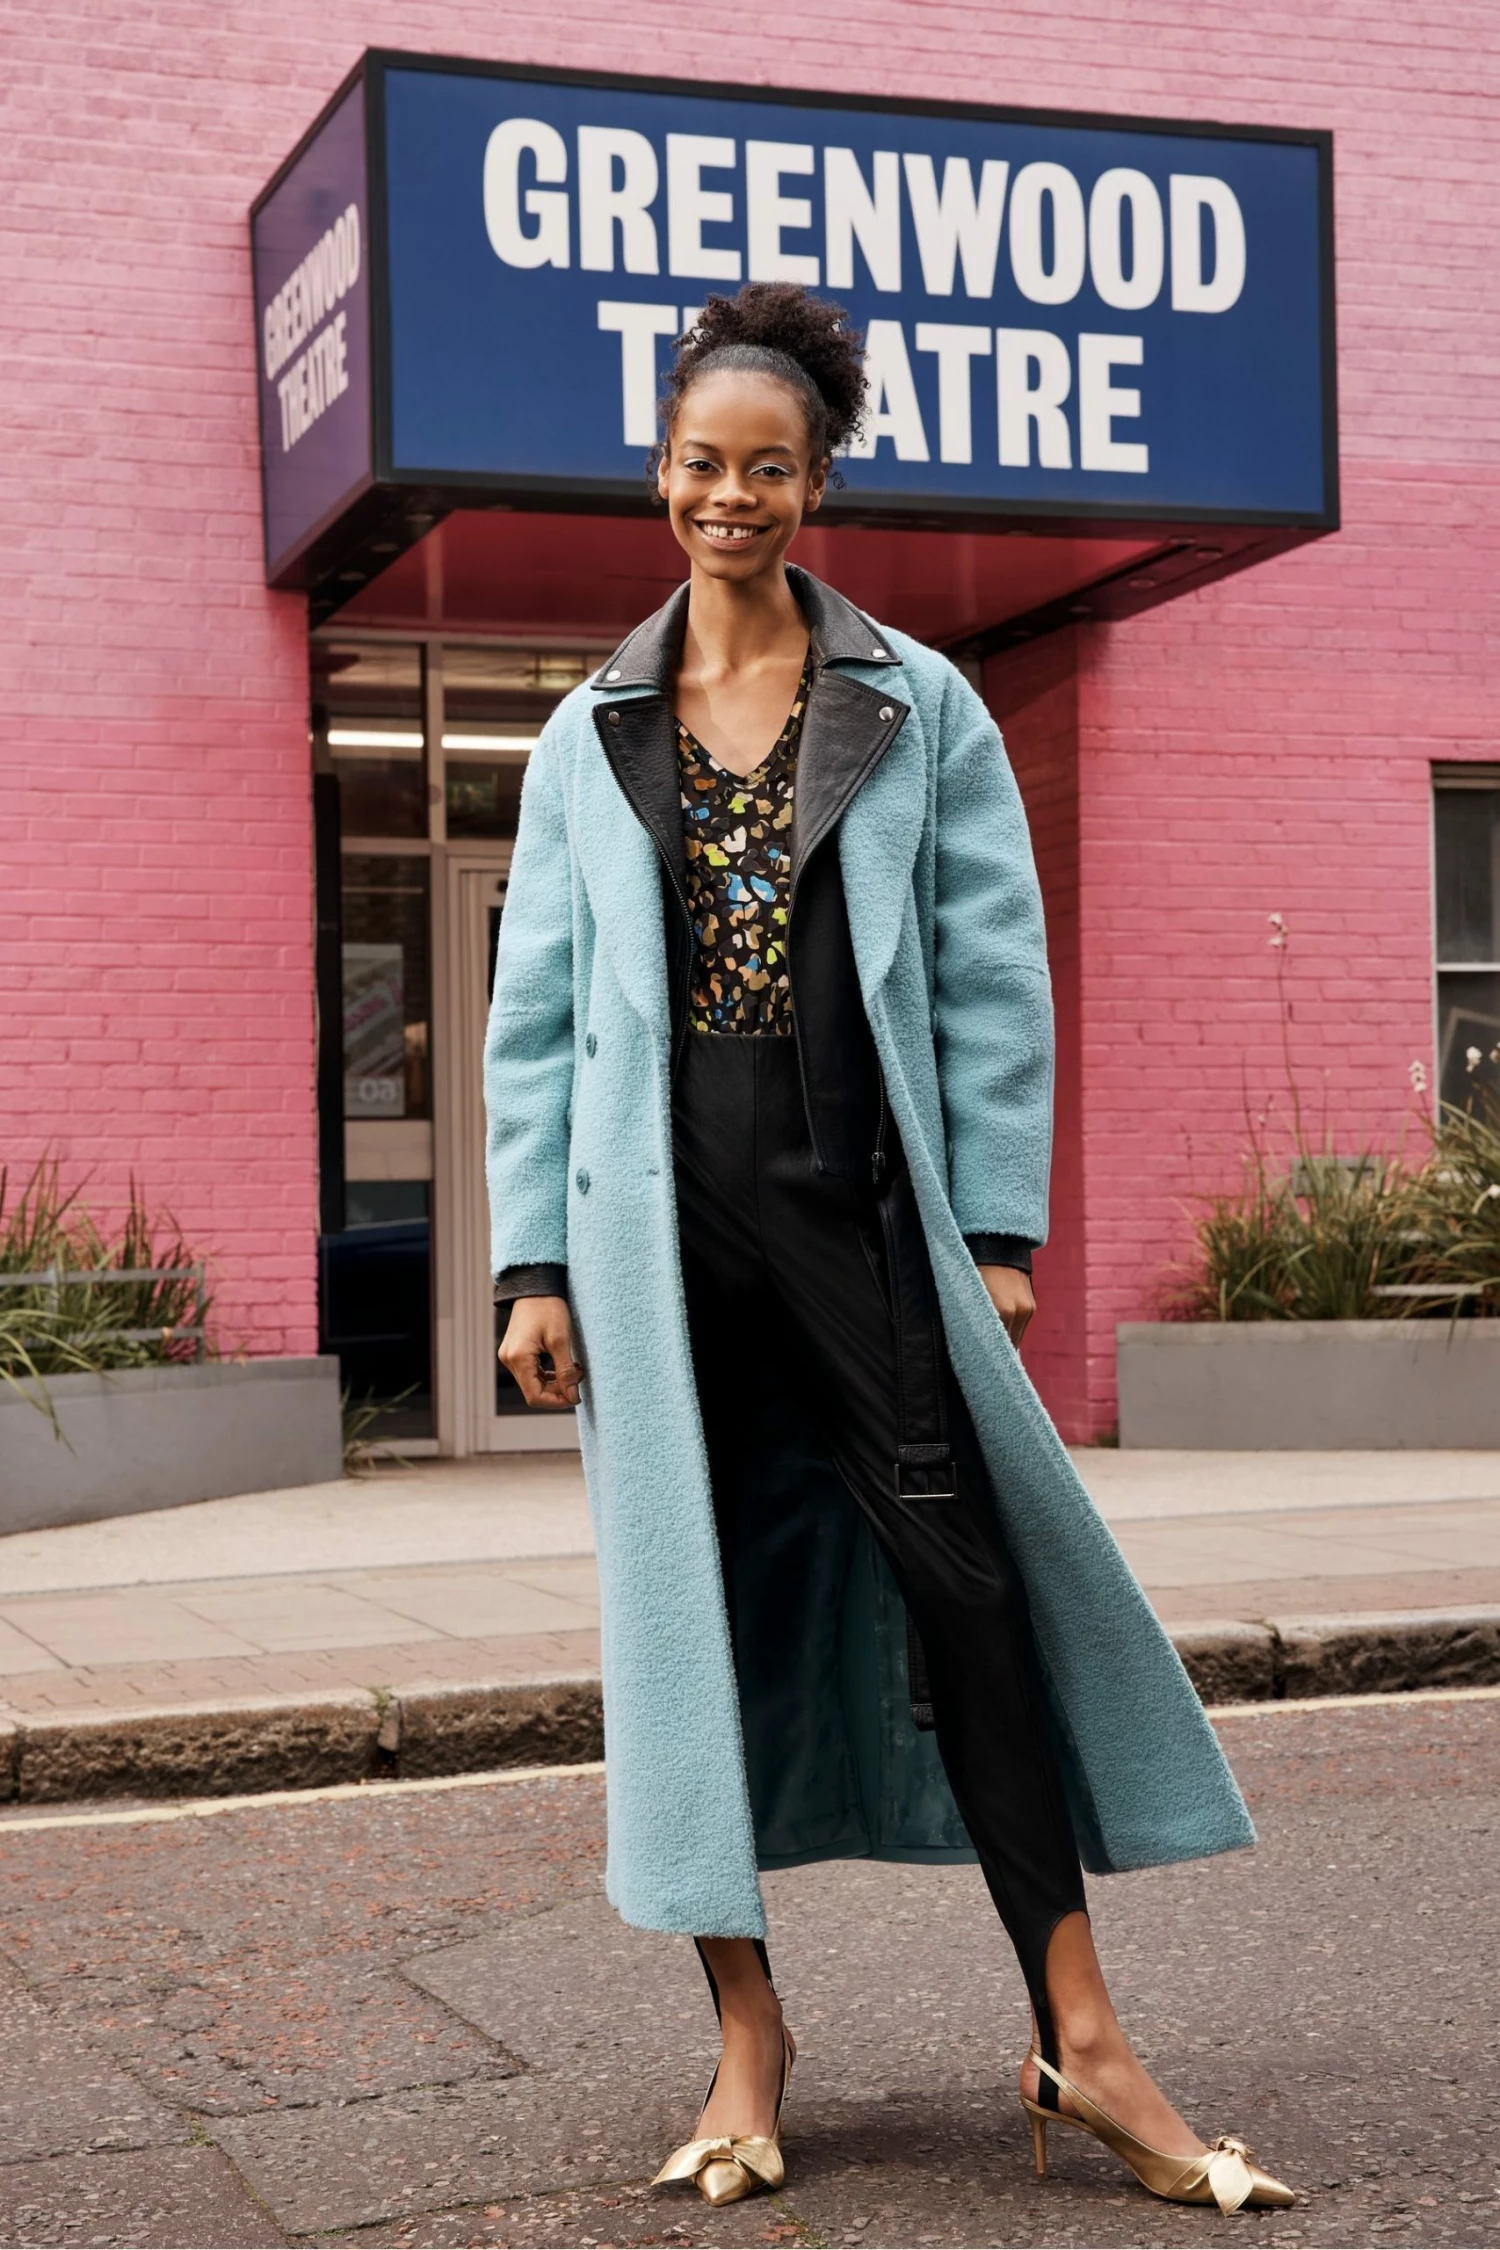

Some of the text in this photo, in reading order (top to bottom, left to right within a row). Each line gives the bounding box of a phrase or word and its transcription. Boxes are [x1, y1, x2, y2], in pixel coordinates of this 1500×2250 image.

[264, 203, 361, 380] GREENWOOD
[484, 118, 1246, 314] GREENWOOD
[278, 311, 349, 452] THEATRE
[598, 301, 1149, 474] TATRE
